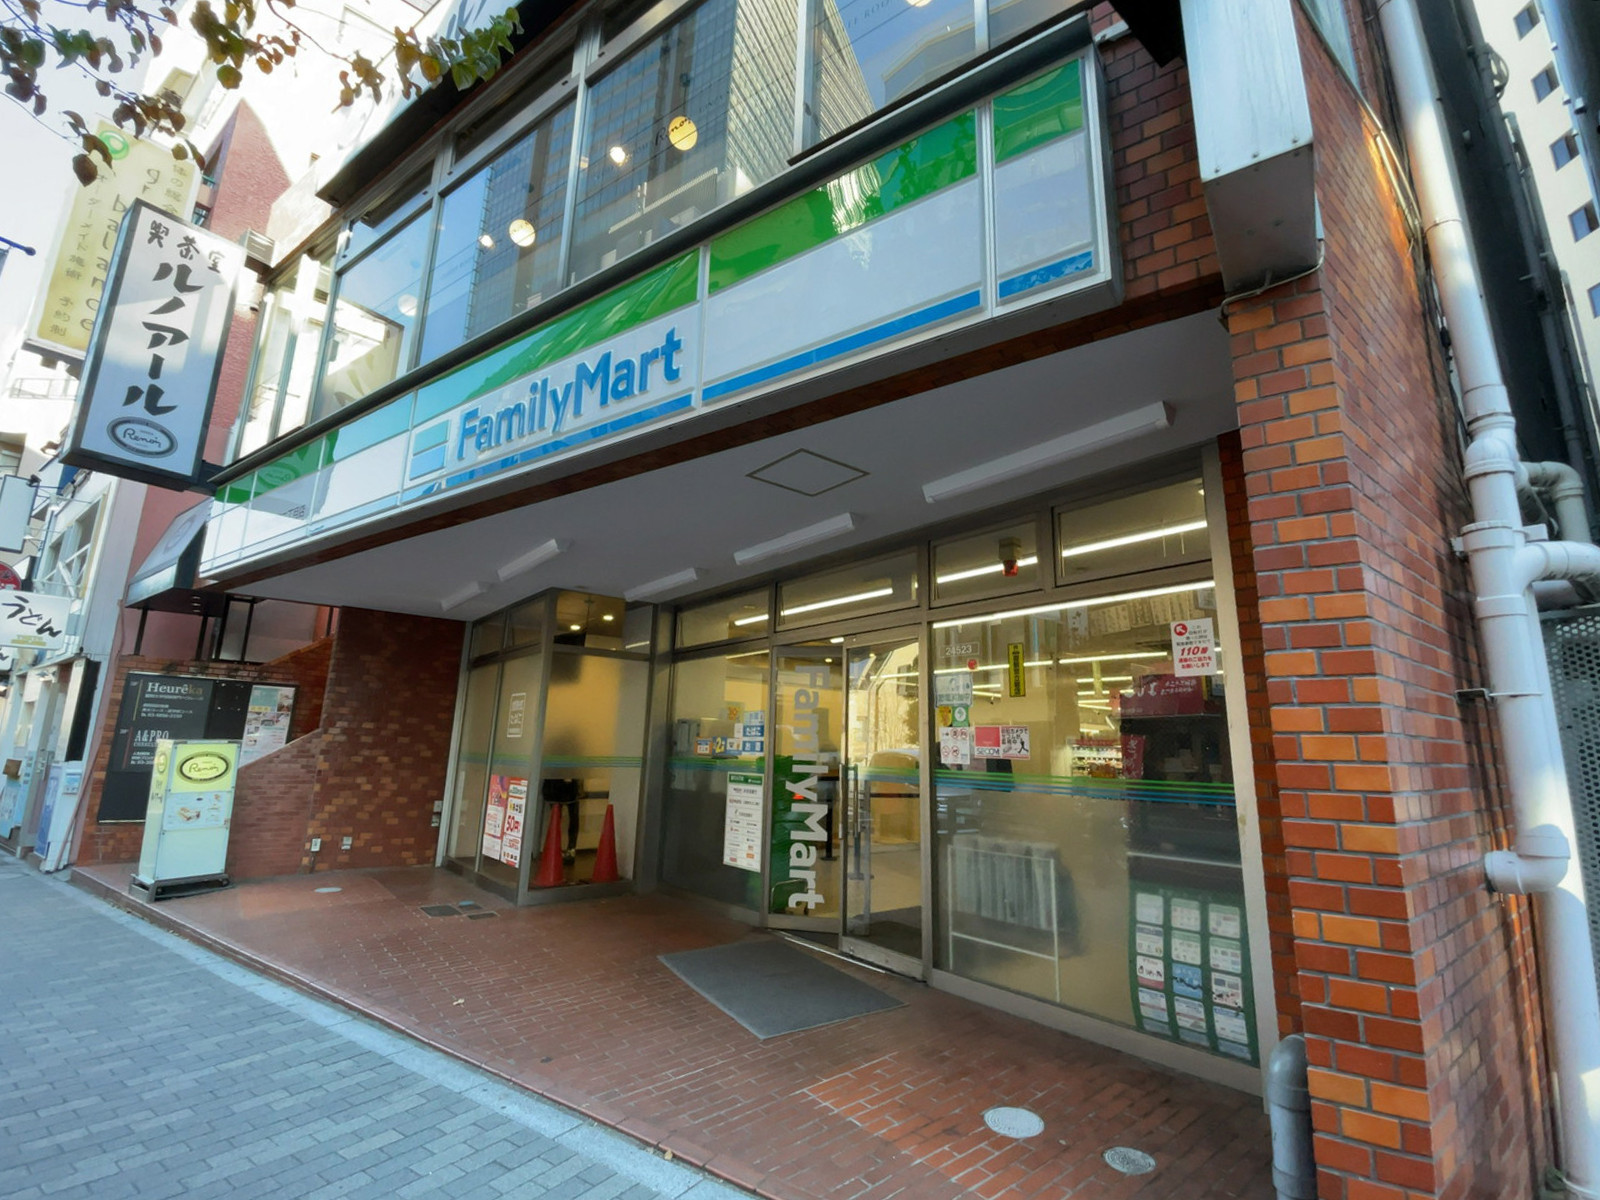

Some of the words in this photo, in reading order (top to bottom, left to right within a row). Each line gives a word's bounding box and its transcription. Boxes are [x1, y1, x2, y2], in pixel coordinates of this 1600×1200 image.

[147, 219, 225, 274] 喫茶室
[121, 262, 205, 416] ルノアール
[456, 326, 684, 461] FamilyMart
[1, 595, 62, 638] うどん
[785, 665, 831, 910] FamilyMart
